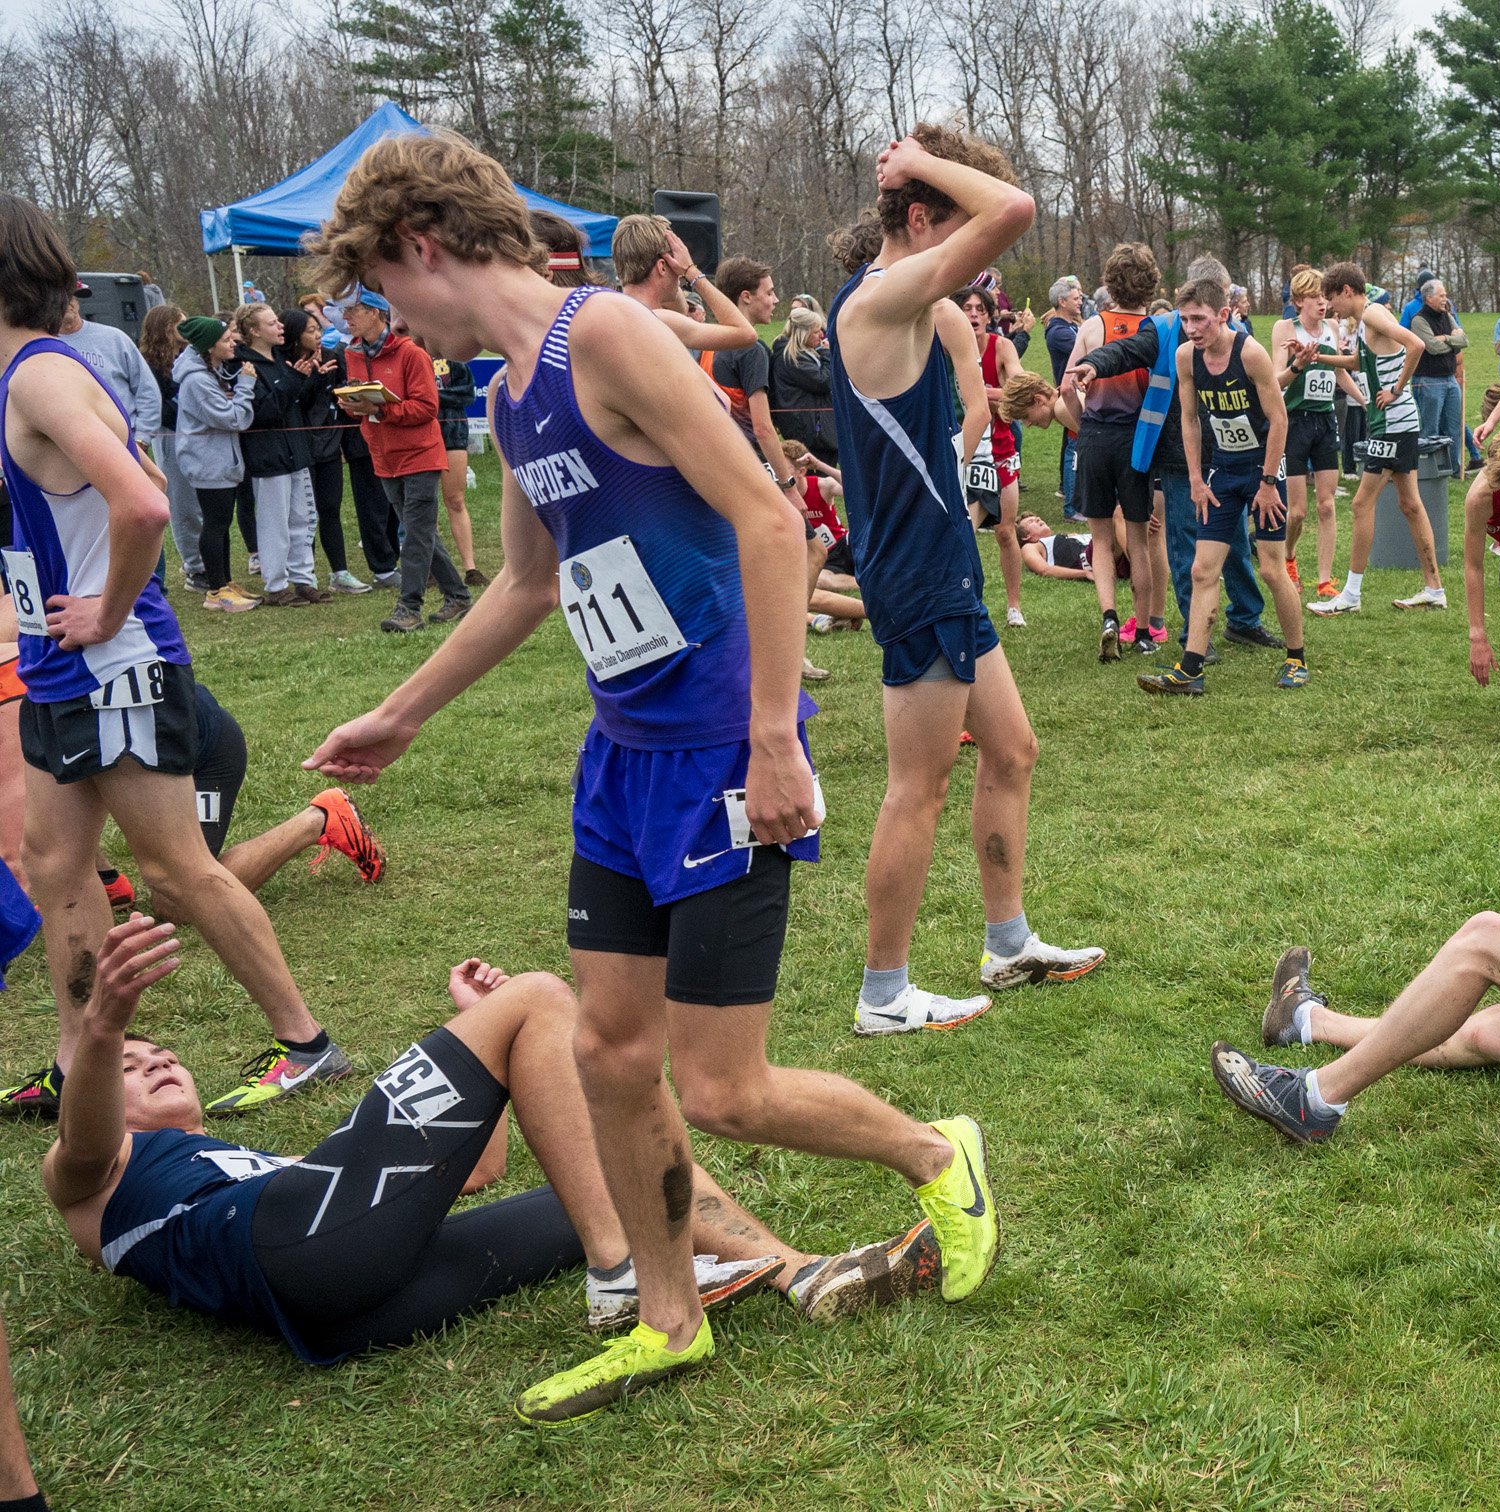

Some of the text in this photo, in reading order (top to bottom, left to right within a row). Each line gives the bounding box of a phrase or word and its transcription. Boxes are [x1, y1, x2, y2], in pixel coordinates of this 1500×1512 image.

[1309, 379, 1333, 393] 640
[1217, 388, 1250, 411] BLUE
[1215, 428, 1249, 444] 738
[1370, 440, 1394, 457] 637
[969, 465, 995, 490] 641
[567, 582, 645, 652] 711
[615, 633, 669, 663] Championship
[376, 1047, 452, 1121] 752
